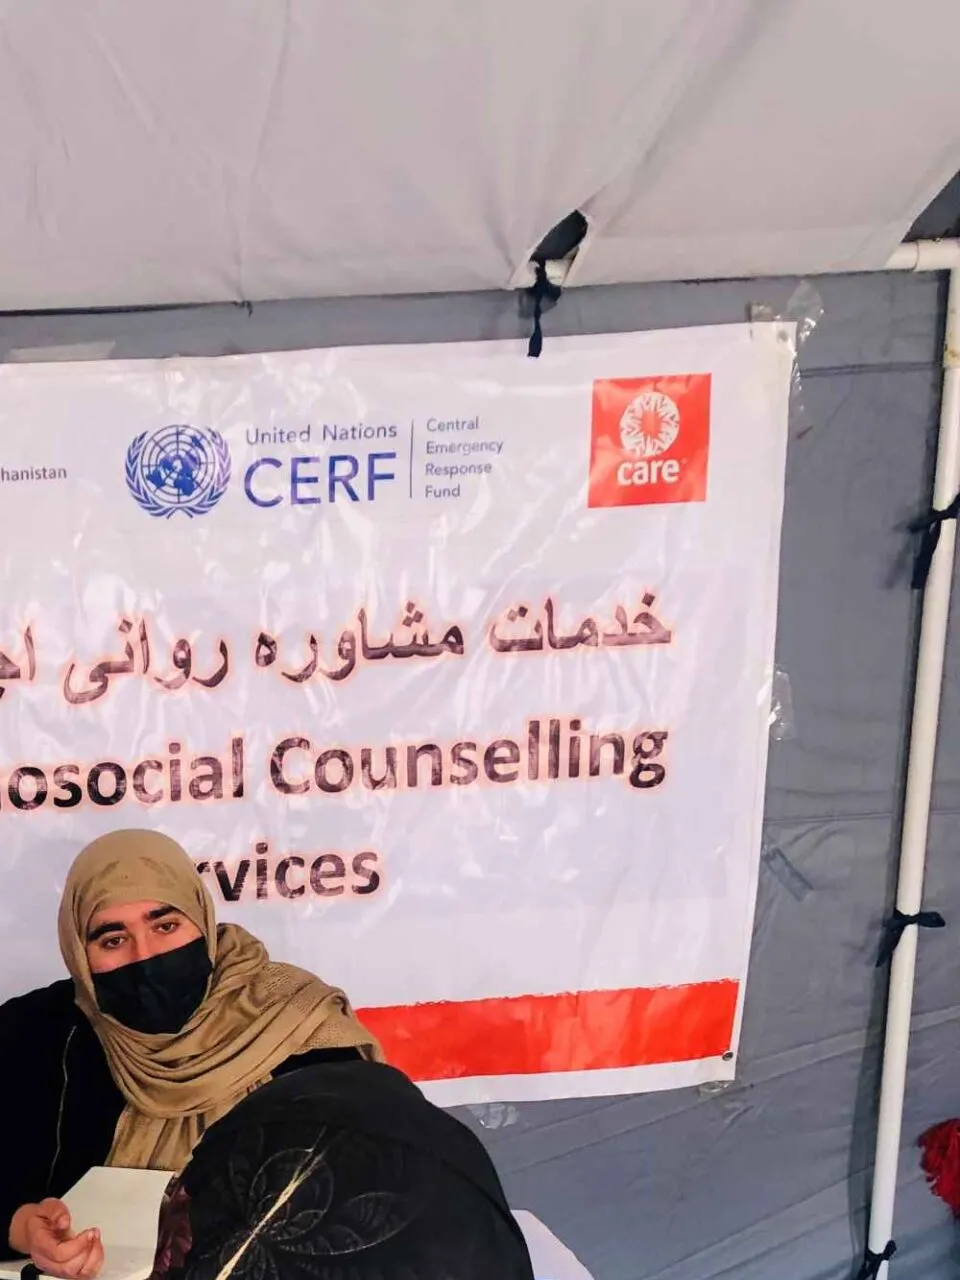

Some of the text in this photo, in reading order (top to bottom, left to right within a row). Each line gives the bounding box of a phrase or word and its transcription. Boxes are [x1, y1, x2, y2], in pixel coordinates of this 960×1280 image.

[246, 422, 398, 446] United Nations
[426, 415, 479, 432] Central
[425, 440, 504, 456] Emergency
[243, 451, 397, 508] CERF
[424, 462, 493, 480] Response
[616, 459, 680, 486] care
[424, 483, 461, 499] Fund
[489, 592, 672, 653] خدمات
[254, 600, 465, 684] مشاوره
[269, 718, 669, 794] Counselling
[197, 841, 381, 902] vices
